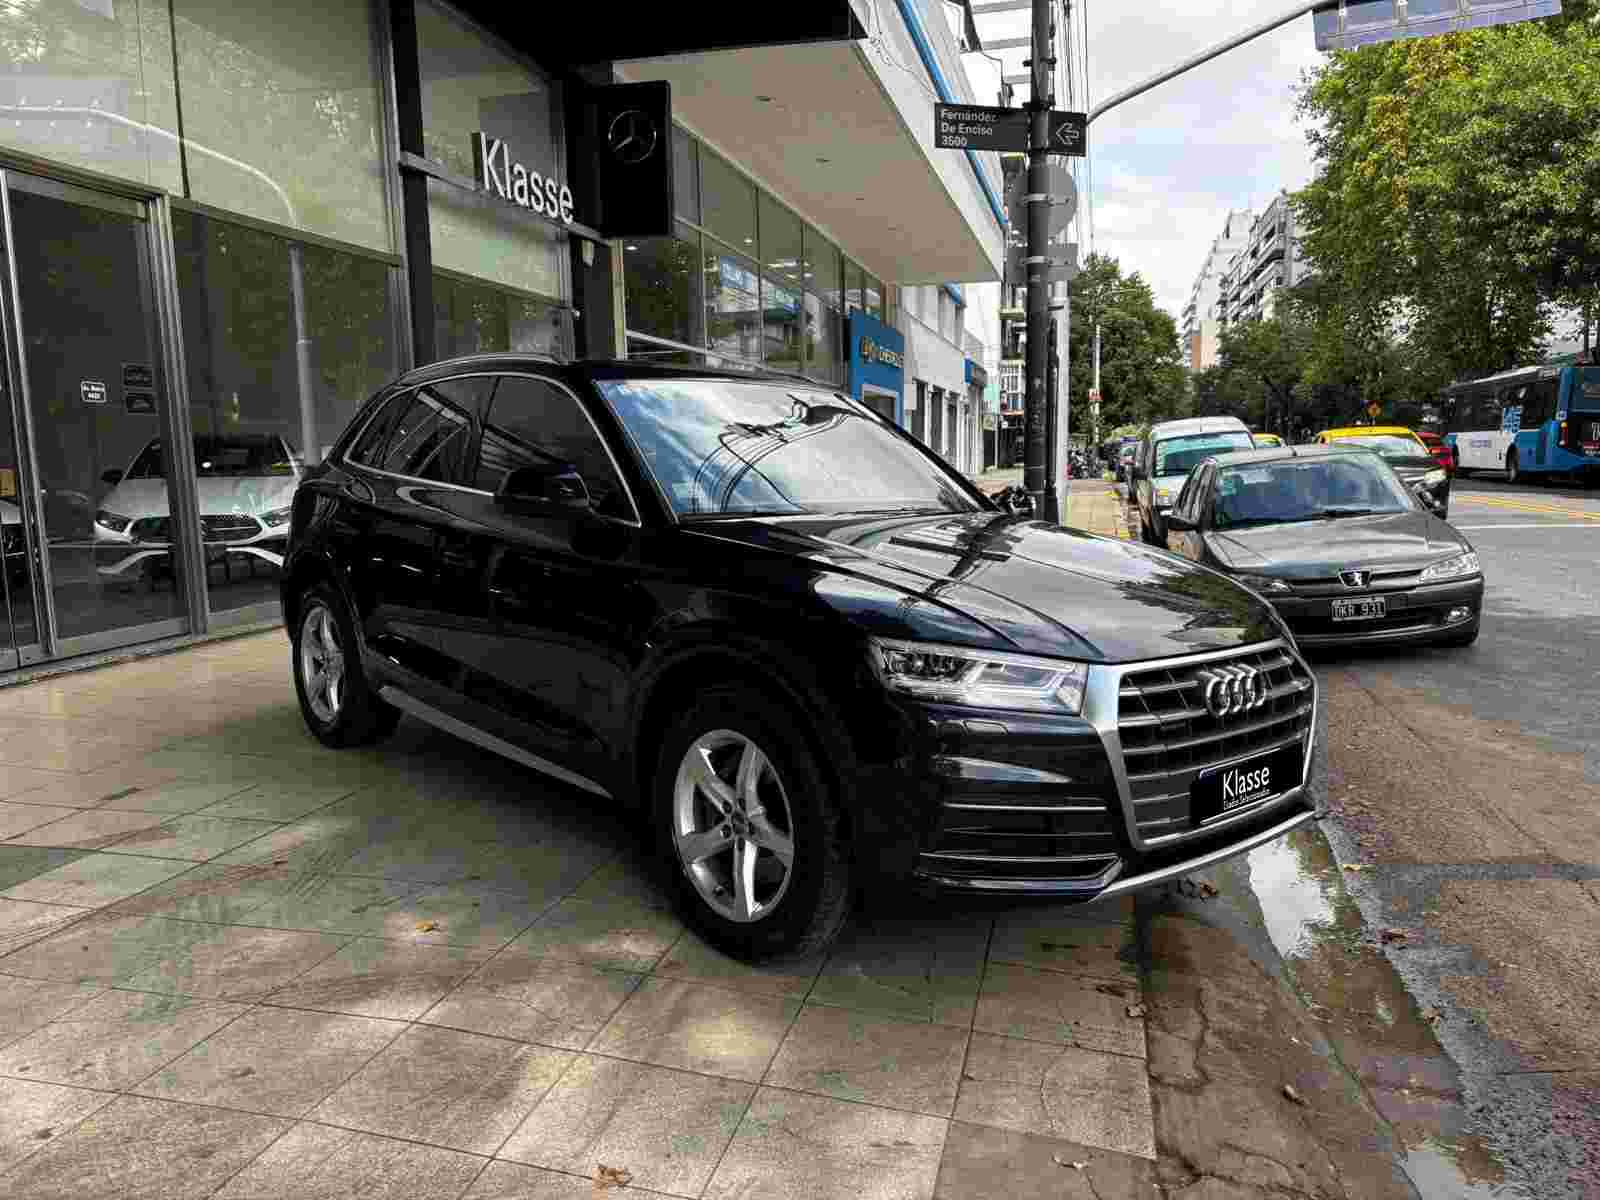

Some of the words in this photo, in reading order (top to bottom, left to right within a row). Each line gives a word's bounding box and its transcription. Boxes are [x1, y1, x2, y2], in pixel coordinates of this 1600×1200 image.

[941, 122, 956, 133] De
[479, 131, 574, 225] Klasse
[1223, 767, 1270, 801] Klasse
